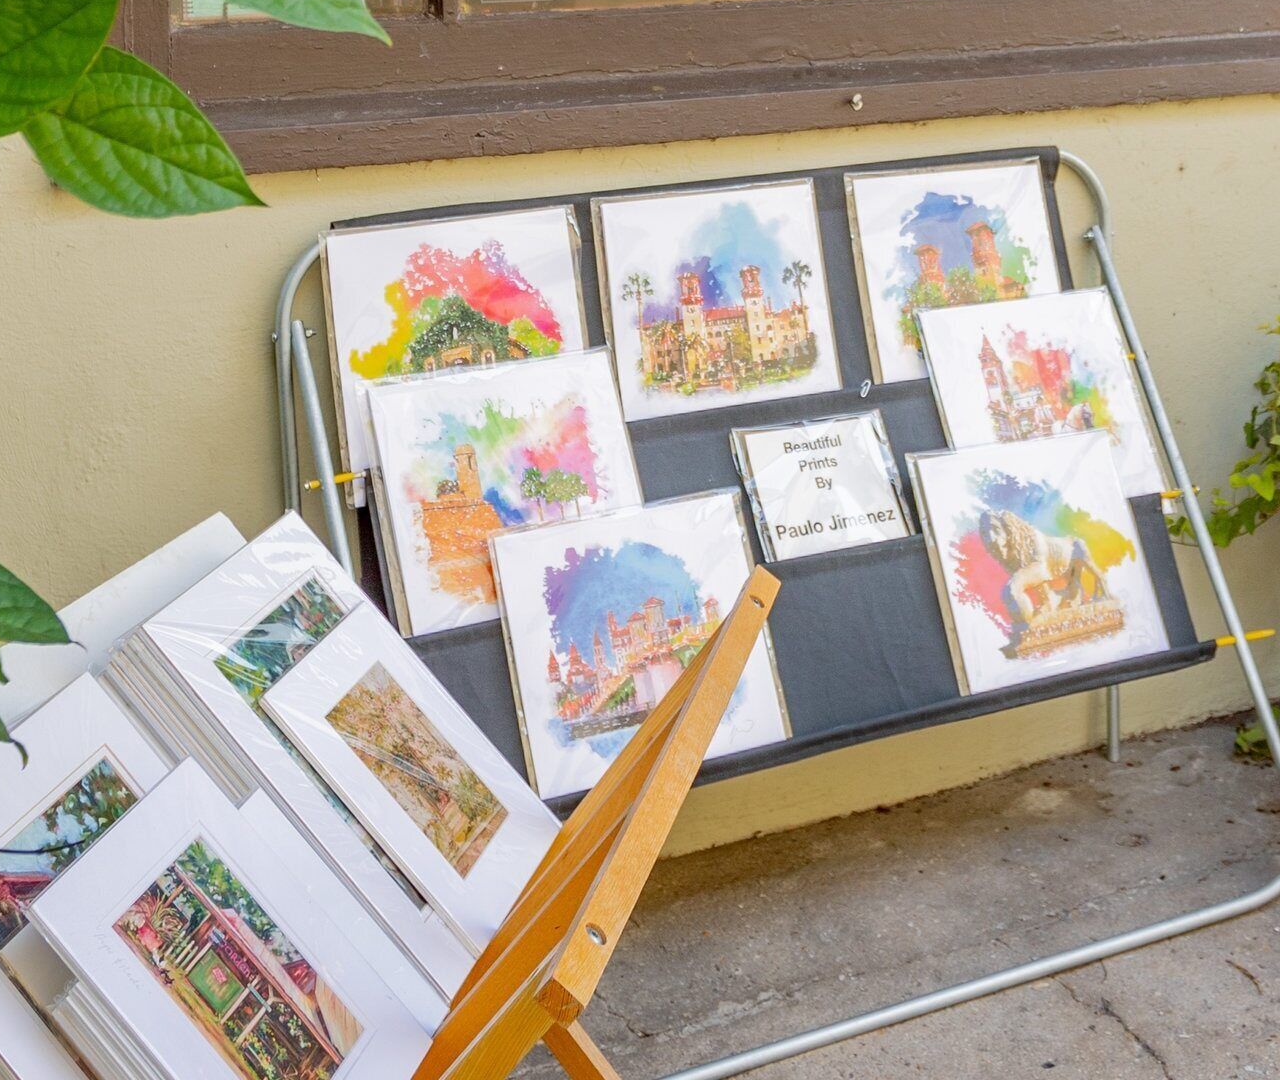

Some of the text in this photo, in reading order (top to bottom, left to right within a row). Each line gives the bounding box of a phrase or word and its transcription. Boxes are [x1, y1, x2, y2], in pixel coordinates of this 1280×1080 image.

[782, 434, 843, 455] Beautiful
[798, 456, 839, 472] Prints
[815, 476, 833, 490] By
[775, 508, 897, 541] Paulo Jimenez
